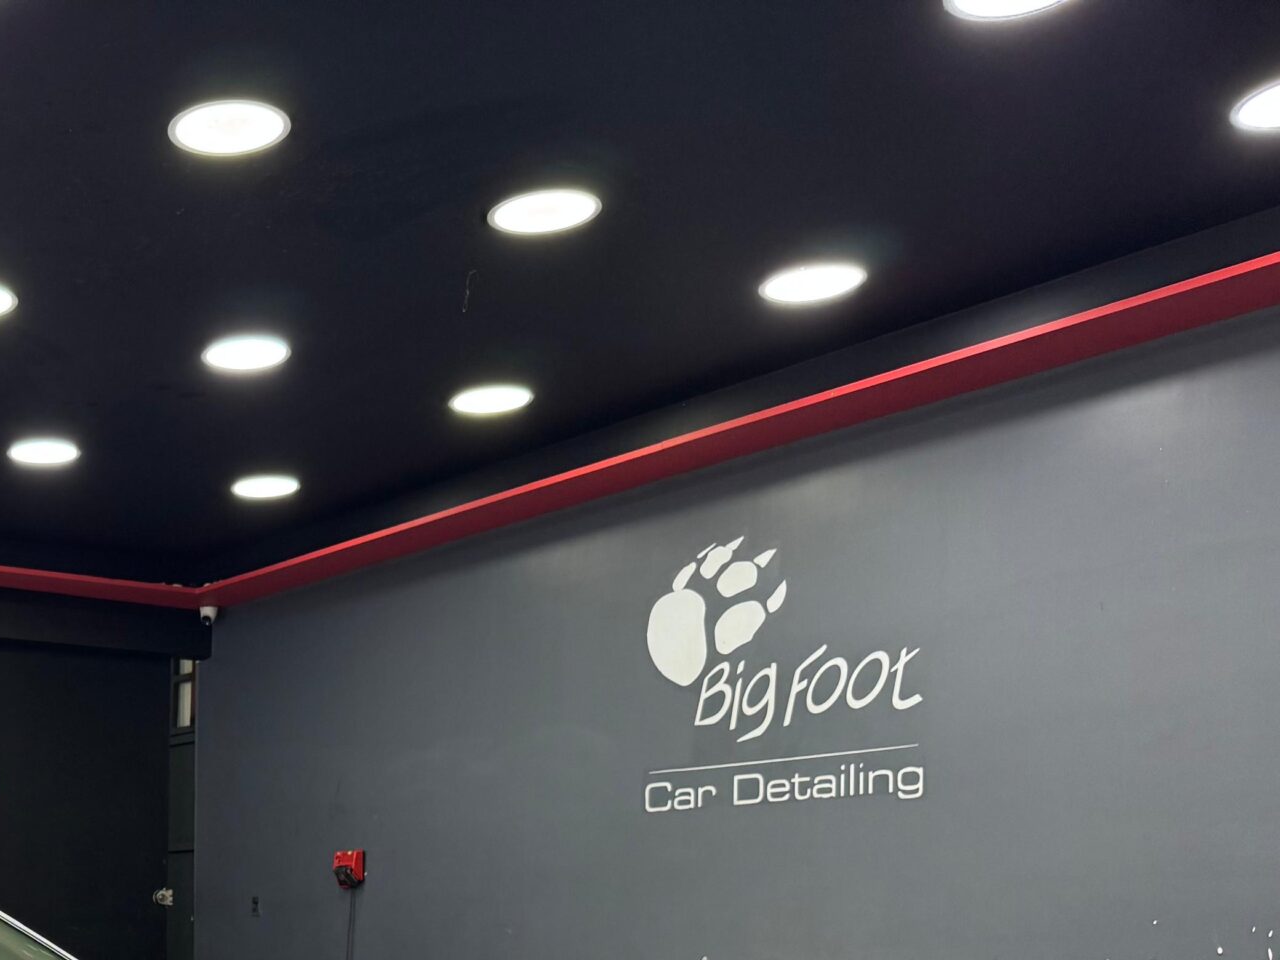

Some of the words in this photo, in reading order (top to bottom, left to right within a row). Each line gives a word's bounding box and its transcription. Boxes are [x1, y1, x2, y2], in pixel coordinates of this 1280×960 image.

[693, 659, 777, 743] Big
[644, 781, 717, 813] Car
[732, 762, 924, 806] Detailing
